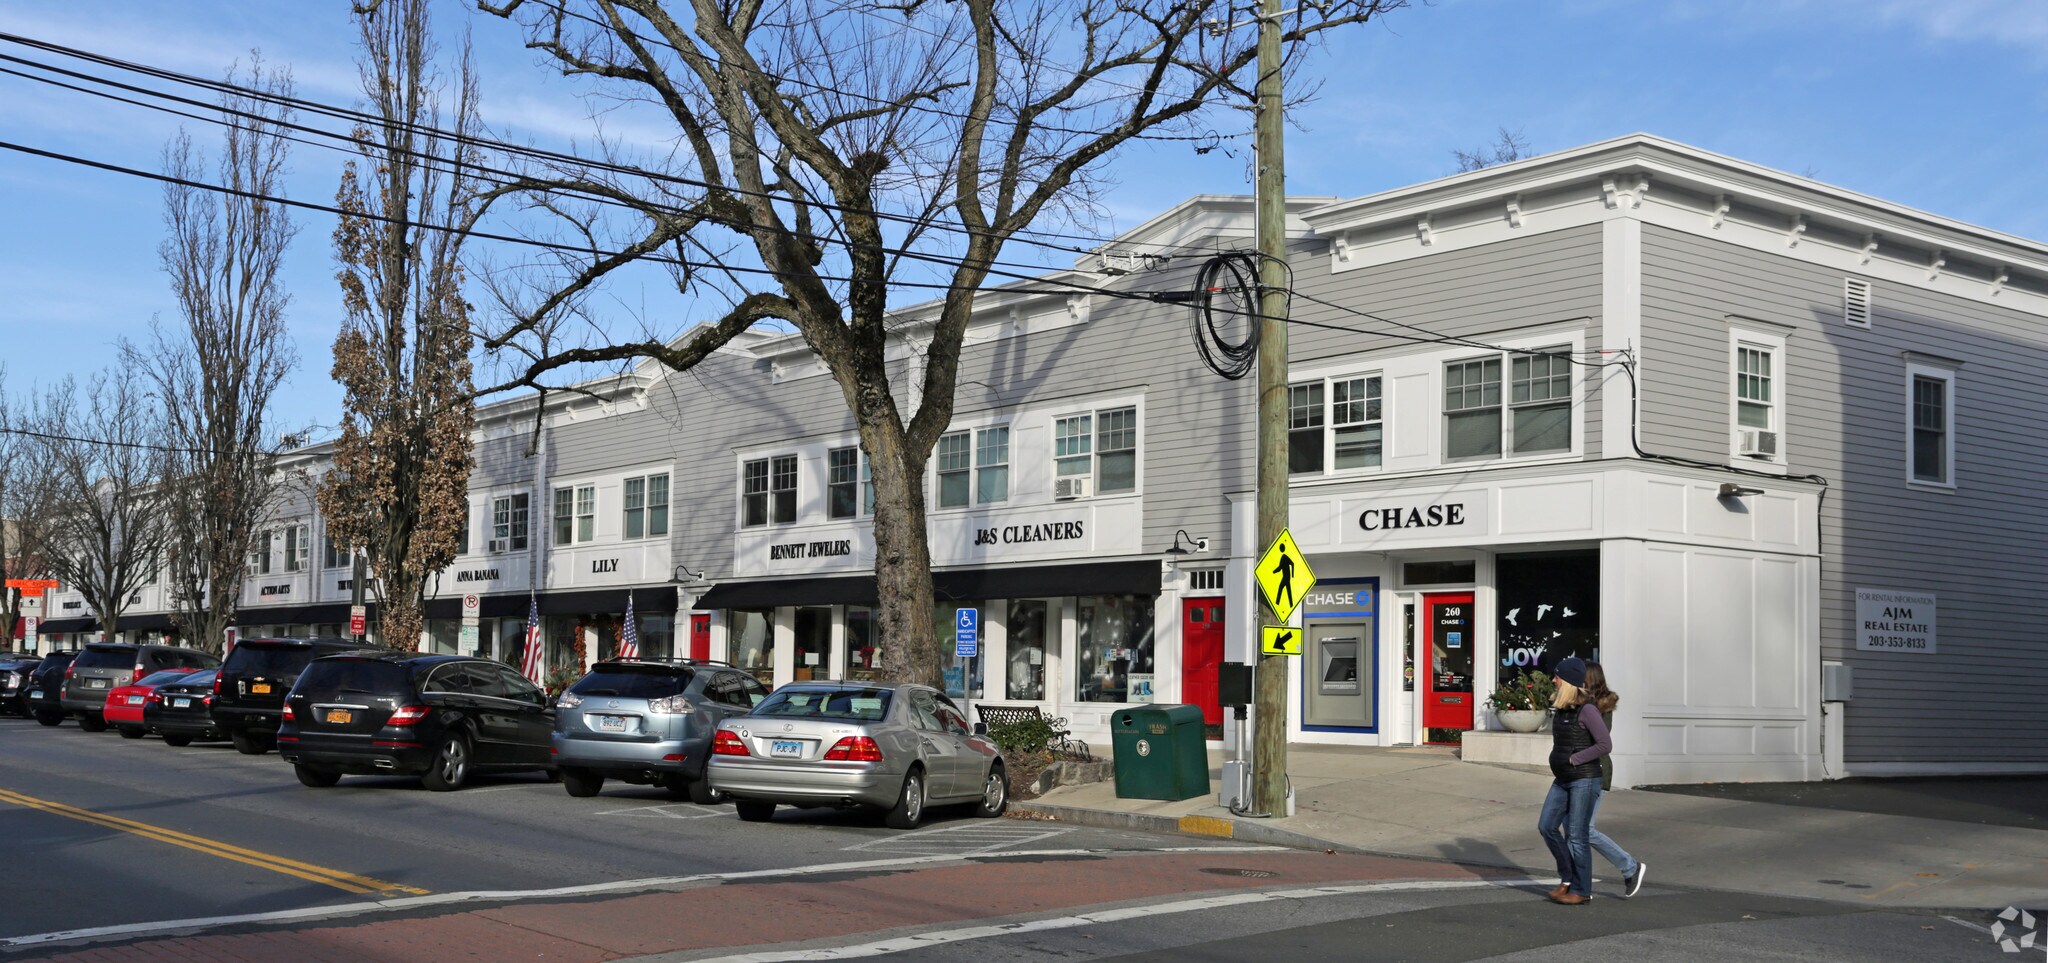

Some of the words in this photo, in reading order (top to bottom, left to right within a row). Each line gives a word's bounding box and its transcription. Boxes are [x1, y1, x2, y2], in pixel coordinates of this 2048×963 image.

[1359, 503, 1465, 531] CHASE
[975, 528, 997, 545] J&S
[1003, 521, 1083, 544] CLEANERS
[770, 543, 806, 560] BENNETT
[807, 540, 851, 558] JEWELERS
[592, 559, 619, 573] LILY
[457, 570, 473, 582] ANNA
[474, 569, 499, 581] BANANA
[261, 585, 278, 596] ACTION
[278, 584, 290, 595] ARTS
[1306, 592, 1354, 605] CHASE
[1858, 592, 1871, 601] FOR
[1872, 594, 1894, 602] RENTAL
[1895, 595, 1934, 605] INFORMATION
[1445, 607, 1460, 617] 260
[1883, 607, 1912, 620] AJM
[1865, 621, 1891, 631] REAL
[1893, 622, 1928, 633] ESTATE
[1502, 647, 1543, 667] JOY
[742, 730, 749, 738] Q
